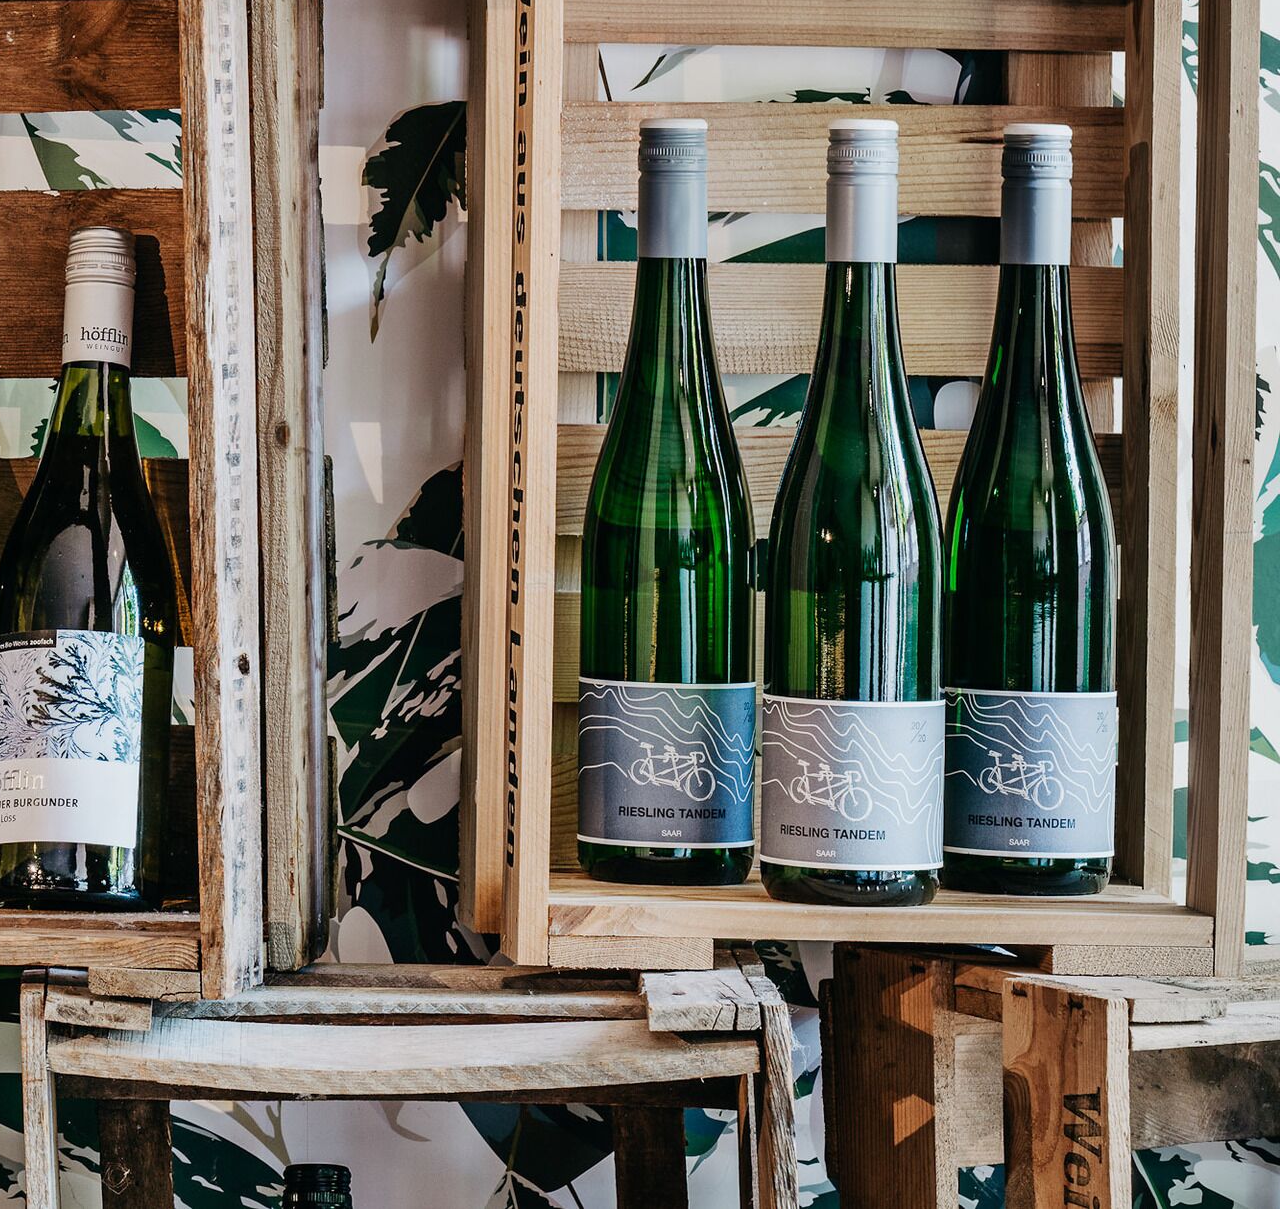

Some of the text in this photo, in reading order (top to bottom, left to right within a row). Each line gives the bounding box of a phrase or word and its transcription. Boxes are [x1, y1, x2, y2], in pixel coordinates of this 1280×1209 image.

[516, 129, 527, 245] aus
[80, 326, 129, 347] höfflin
[86, 343, 124, 353] WEINGUT
[512, 270, 527, 605] deutschen
[506, 629, 521, 868] Landen
[13, 797, 79, 808] BURGUNDER
[618, 805, 727, 820] RIESLING TANDEM
[968, 813, 1076, 830] RIESLING TANDEM
[661, 829, 682, 837] SAAR
[780, 823, 886, 841] RIESLING TANDEM
[1008, 838, 1030, 847] SAAR
[815, 849, 837, 859] SAAR
